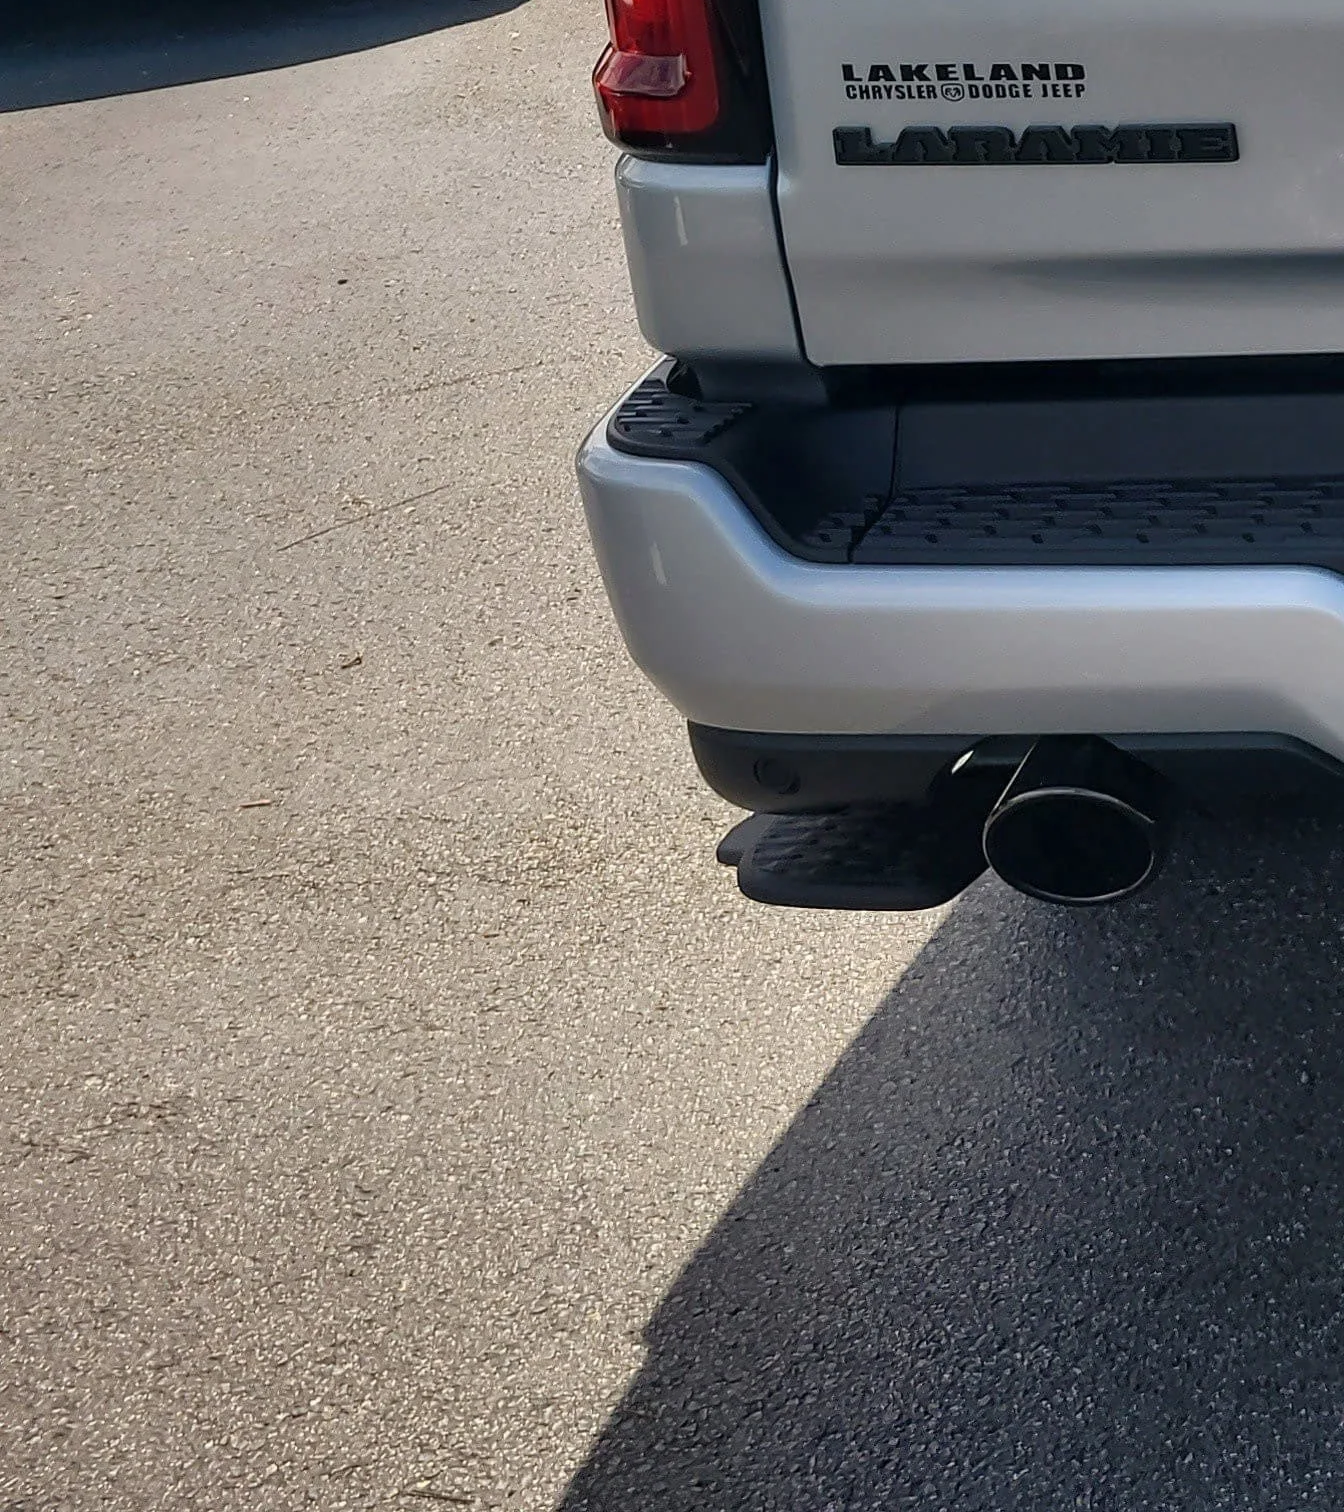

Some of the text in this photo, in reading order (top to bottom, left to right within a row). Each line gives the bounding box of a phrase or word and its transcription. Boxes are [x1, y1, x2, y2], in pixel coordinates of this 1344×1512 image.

[841, 63, 1087, 82] LAKELAND
[845, 82, 1086, 100] CHRYSLER DODGE JEEP
[833, 121, 1241, 166] LARAMIE
